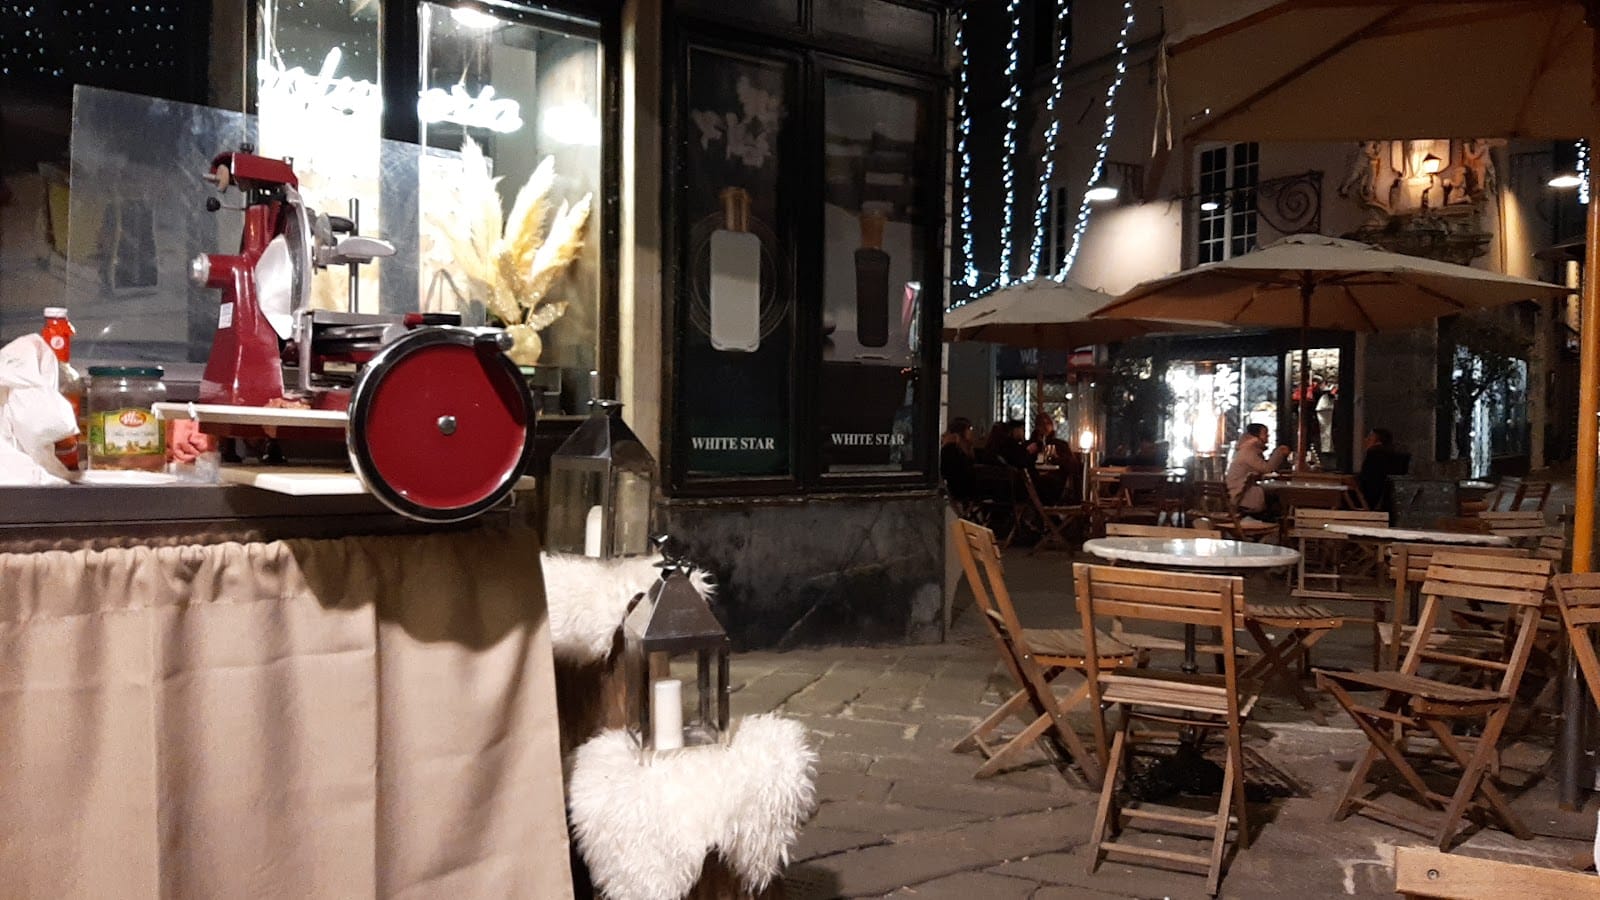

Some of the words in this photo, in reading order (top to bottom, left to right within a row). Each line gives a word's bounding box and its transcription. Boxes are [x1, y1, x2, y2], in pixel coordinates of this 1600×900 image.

[691, 437, 738, 450] WHITE
[740, 437, 775, 450] STAR
[830, 433, 874, 446] WHITE
[875, 433, 905, 446] STAR
